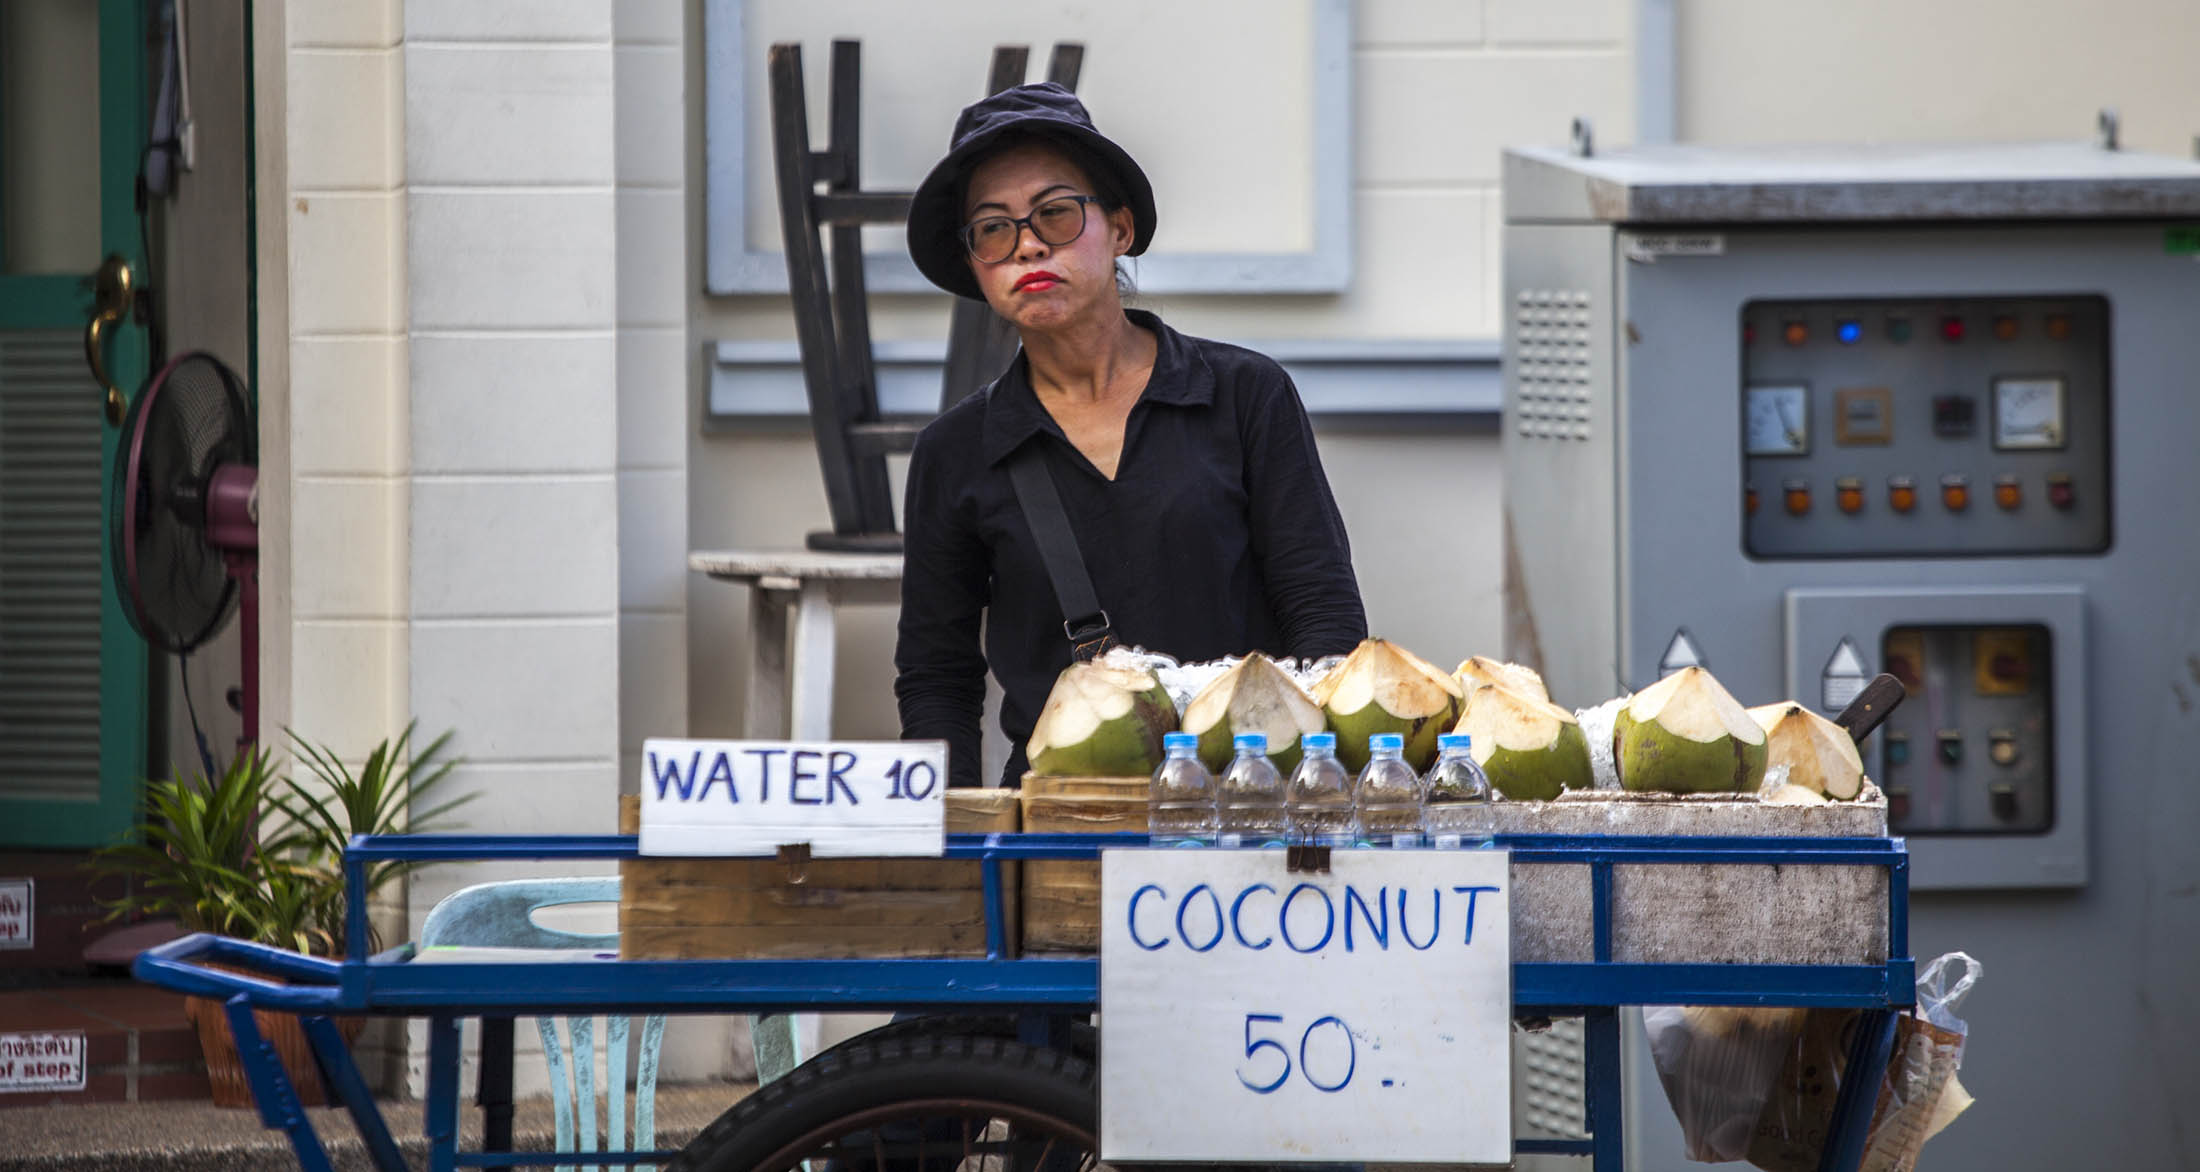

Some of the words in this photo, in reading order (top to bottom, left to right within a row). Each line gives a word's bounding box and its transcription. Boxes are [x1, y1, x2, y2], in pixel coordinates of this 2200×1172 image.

[649, 750, 859, 806] WATER
[885, 760, 936, 801] 10
[1128, 883, 1501, 956] COCONUT
[24, 1062, 71, 1080] step
